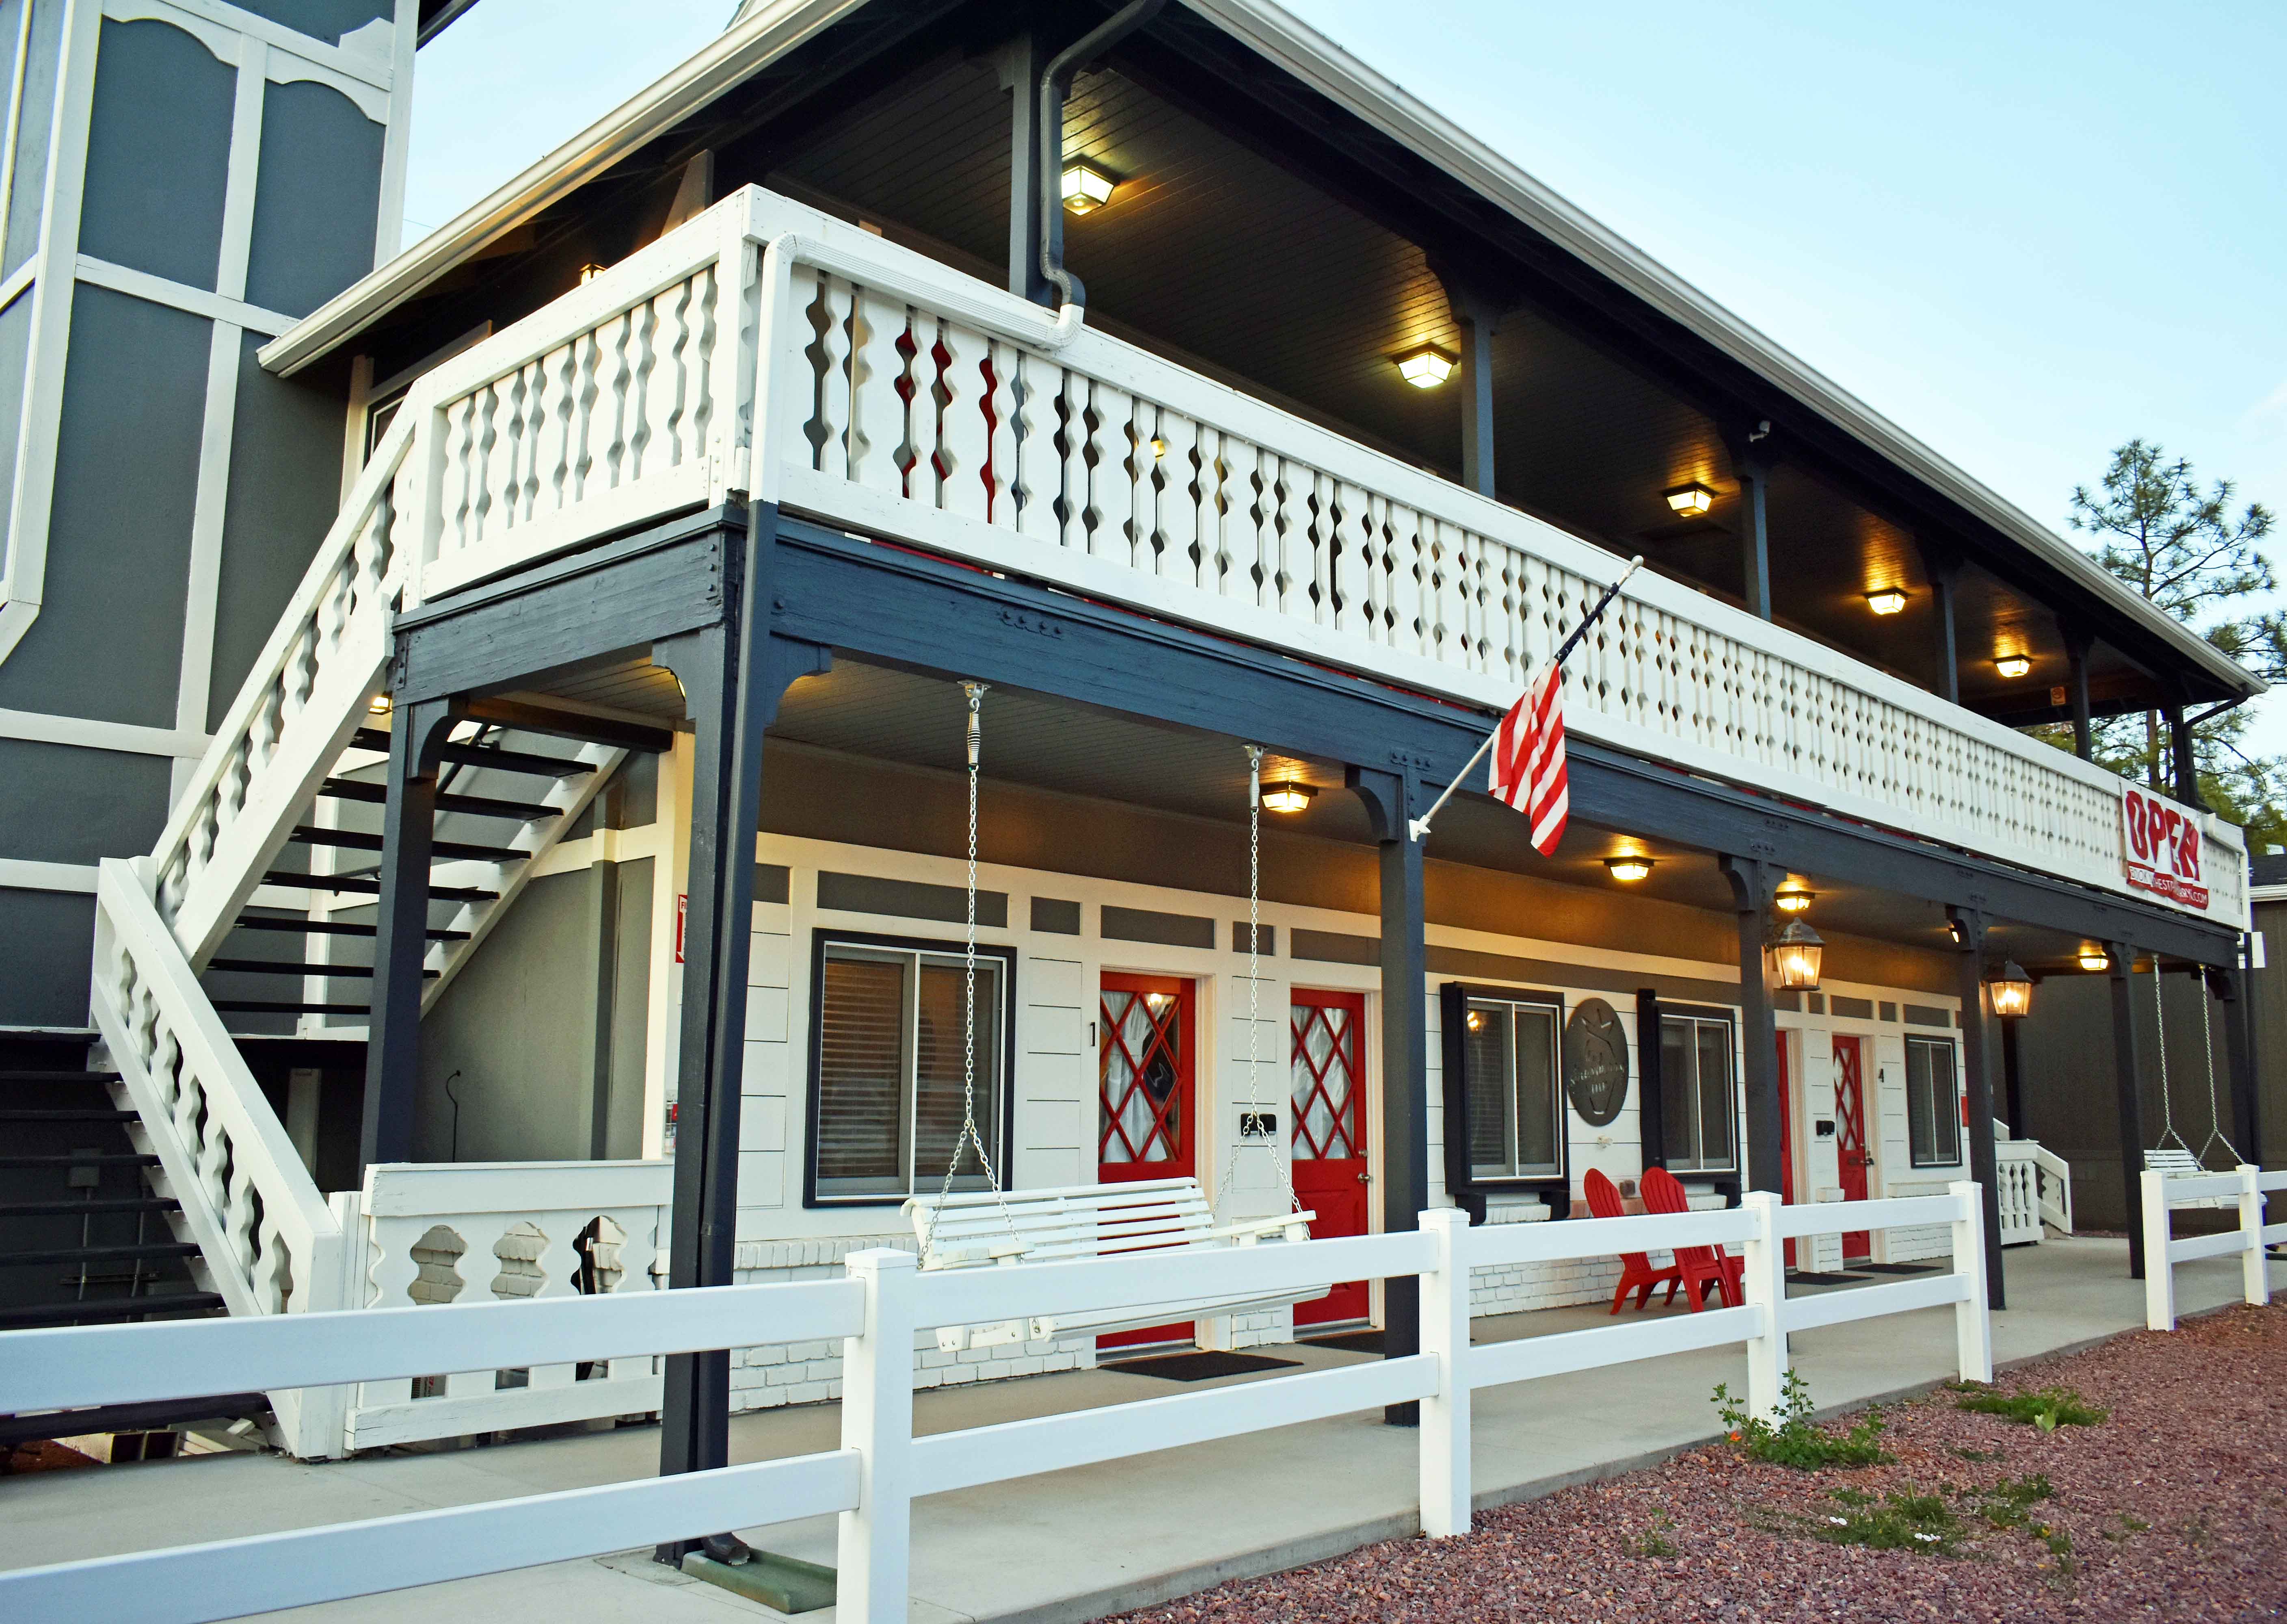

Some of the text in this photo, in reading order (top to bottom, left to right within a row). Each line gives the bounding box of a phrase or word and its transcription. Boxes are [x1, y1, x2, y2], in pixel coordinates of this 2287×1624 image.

[2125, 790, 2200, 882] OPEN
[1089, 1021, 1095, 1047] 1
[1878, 1068, 1884, 1083] 4
